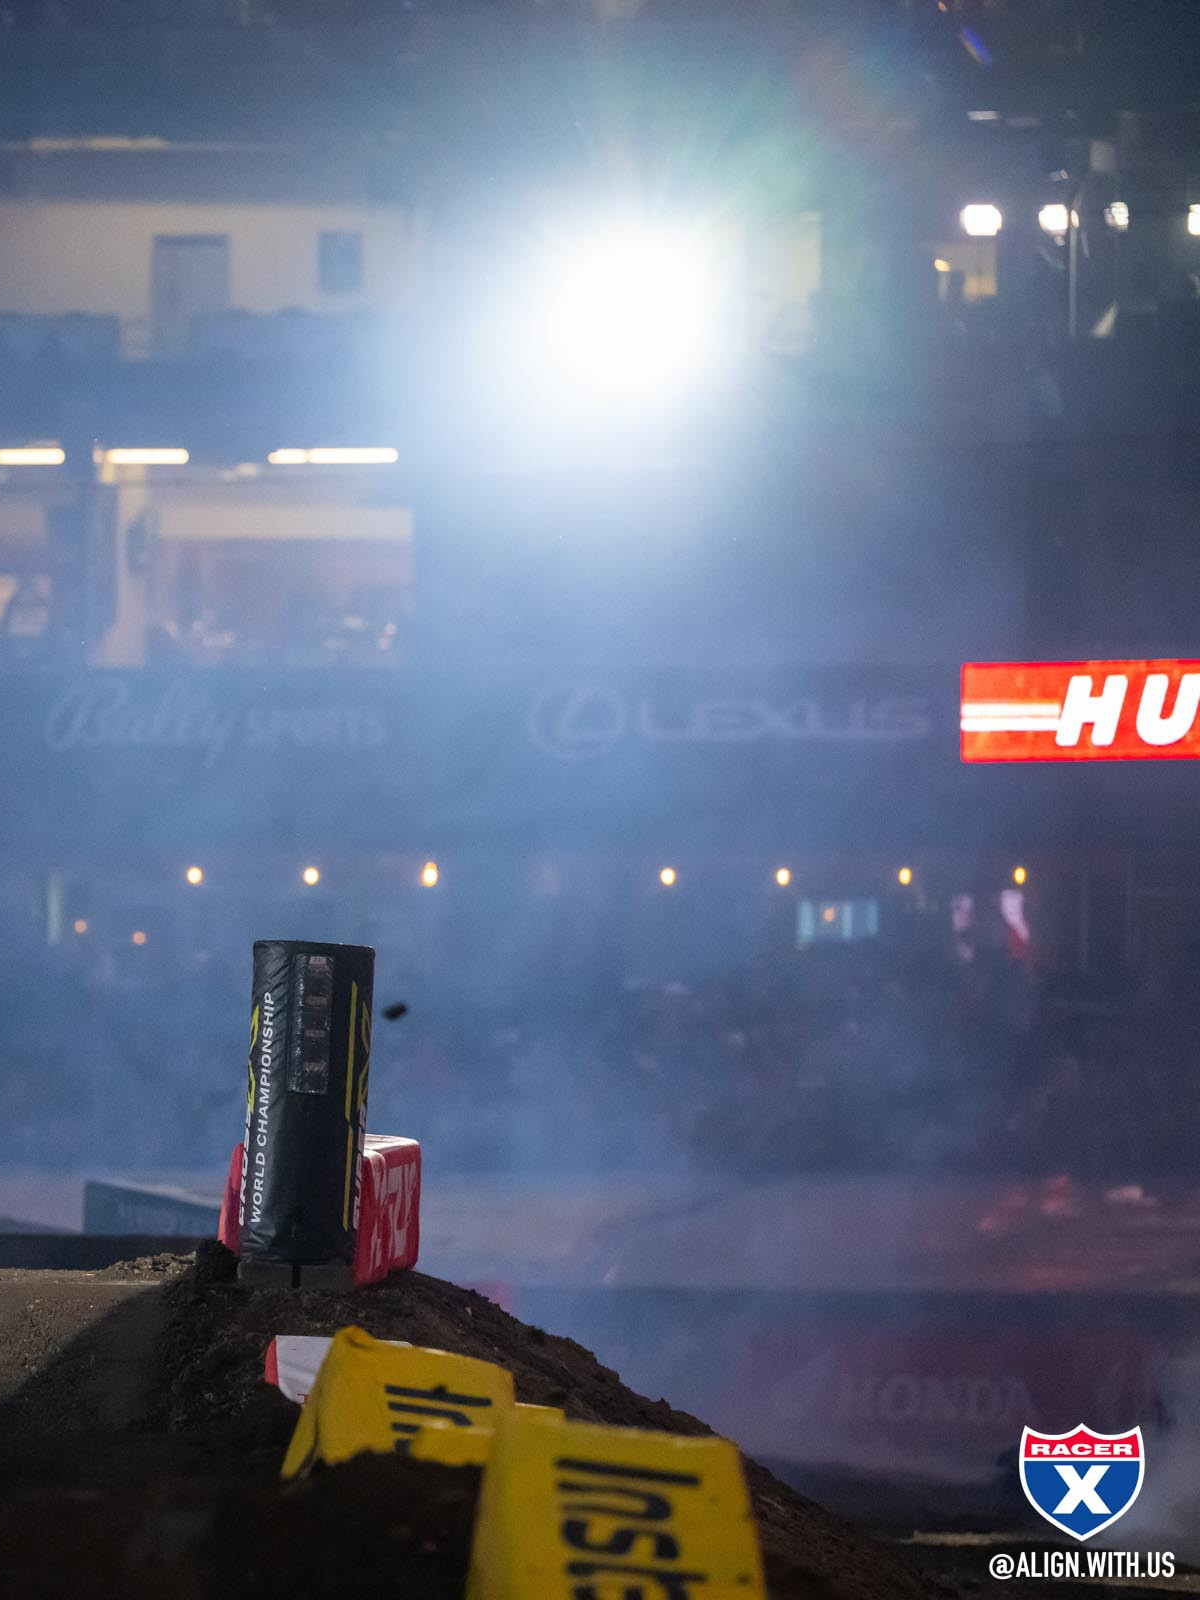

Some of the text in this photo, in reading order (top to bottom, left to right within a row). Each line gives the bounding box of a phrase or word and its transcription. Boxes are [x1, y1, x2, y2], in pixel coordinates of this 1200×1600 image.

[637, 696, 930, 741] LEXUS
[250, 991, 275, 1223] WORLD CHAMPIONSHIP
